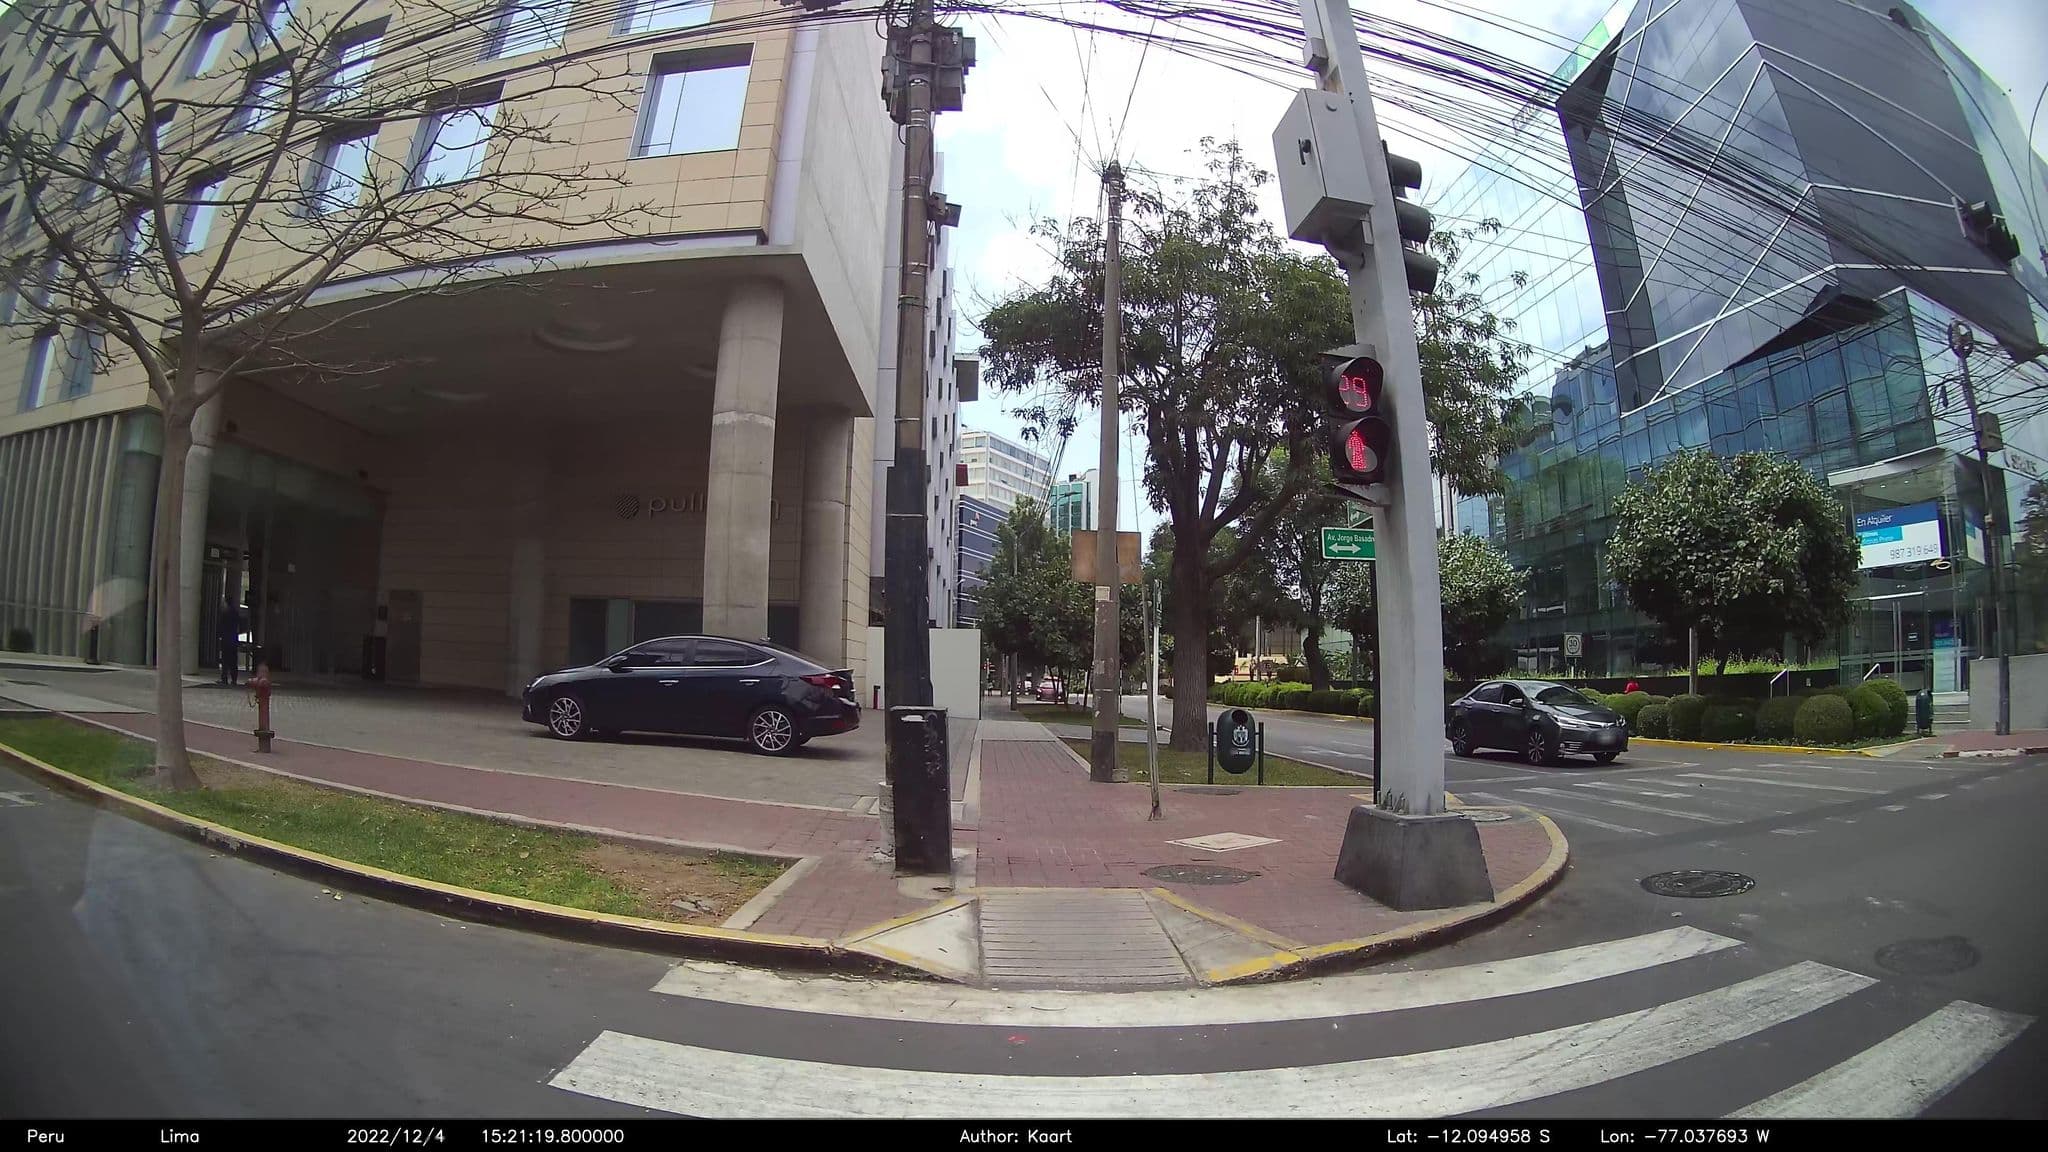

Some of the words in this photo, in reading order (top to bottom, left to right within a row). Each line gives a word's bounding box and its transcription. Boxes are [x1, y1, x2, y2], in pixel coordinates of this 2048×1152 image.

[1856, 517, 1867, 528] En
[1327, 532, 1337, 541] Av.
[1337, 532, 1353, 544] Jorge
[1354, 533, 1375, 543] Basadr
